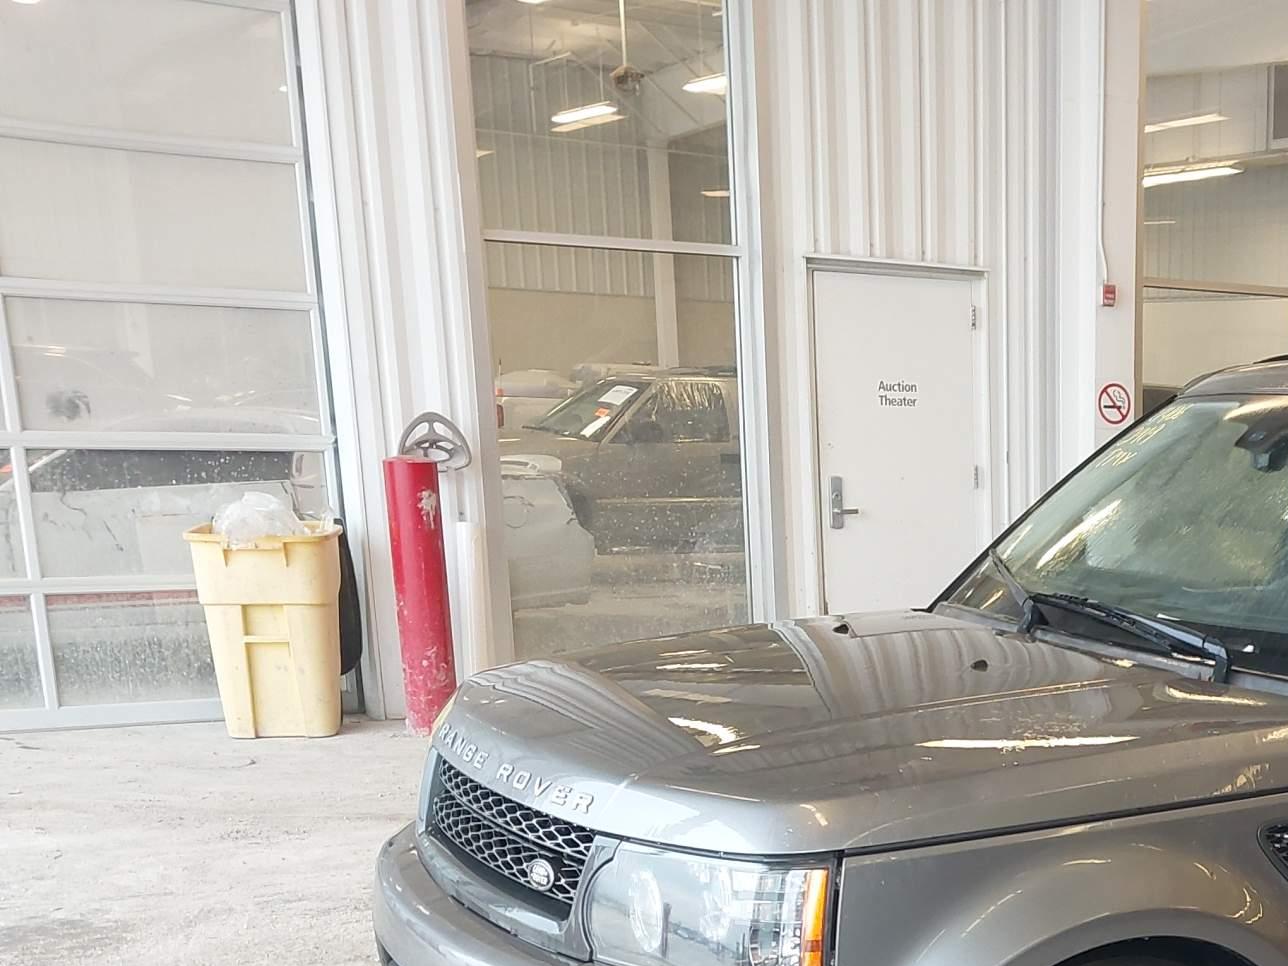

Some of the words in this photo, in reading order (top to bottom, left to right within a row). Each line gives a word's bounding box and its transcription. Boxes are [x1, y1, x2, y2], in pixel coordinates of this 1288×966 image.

[878, 380, 918, 393] Auction
[878, 394, 918, 407] Theater
[438, 722, 489, 770] RANGE
[496, 763, 595, 814] ROVER
